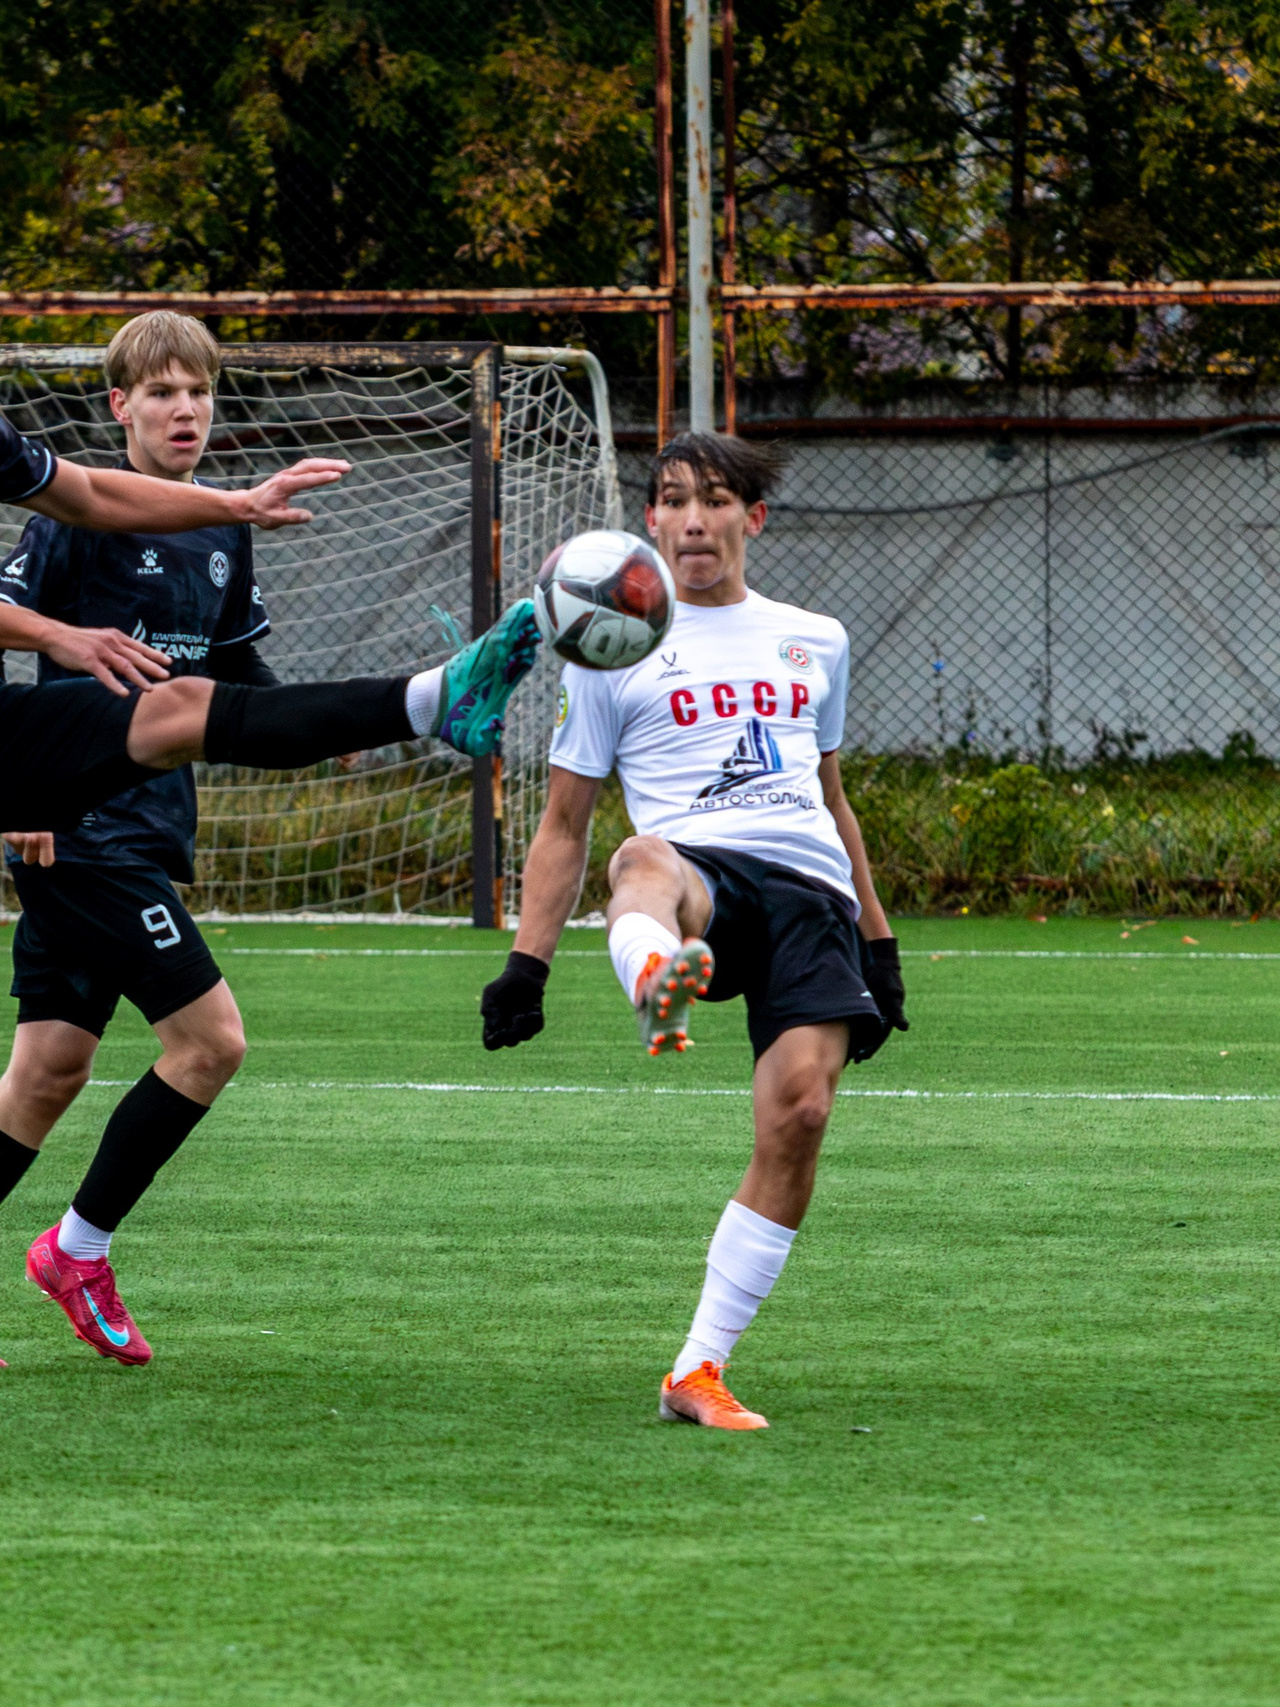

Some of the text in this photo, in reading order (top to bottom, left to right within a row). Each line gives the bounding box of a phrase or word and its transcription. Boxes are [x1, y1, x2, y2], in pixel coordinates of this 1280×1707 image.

[137, 566, 164, 575] KELME
[670, 681, 809, 727] СССР
[689, 792, 819, 811] АВТОСТОЛИЦА
[141, 904, 182, 949] 9
